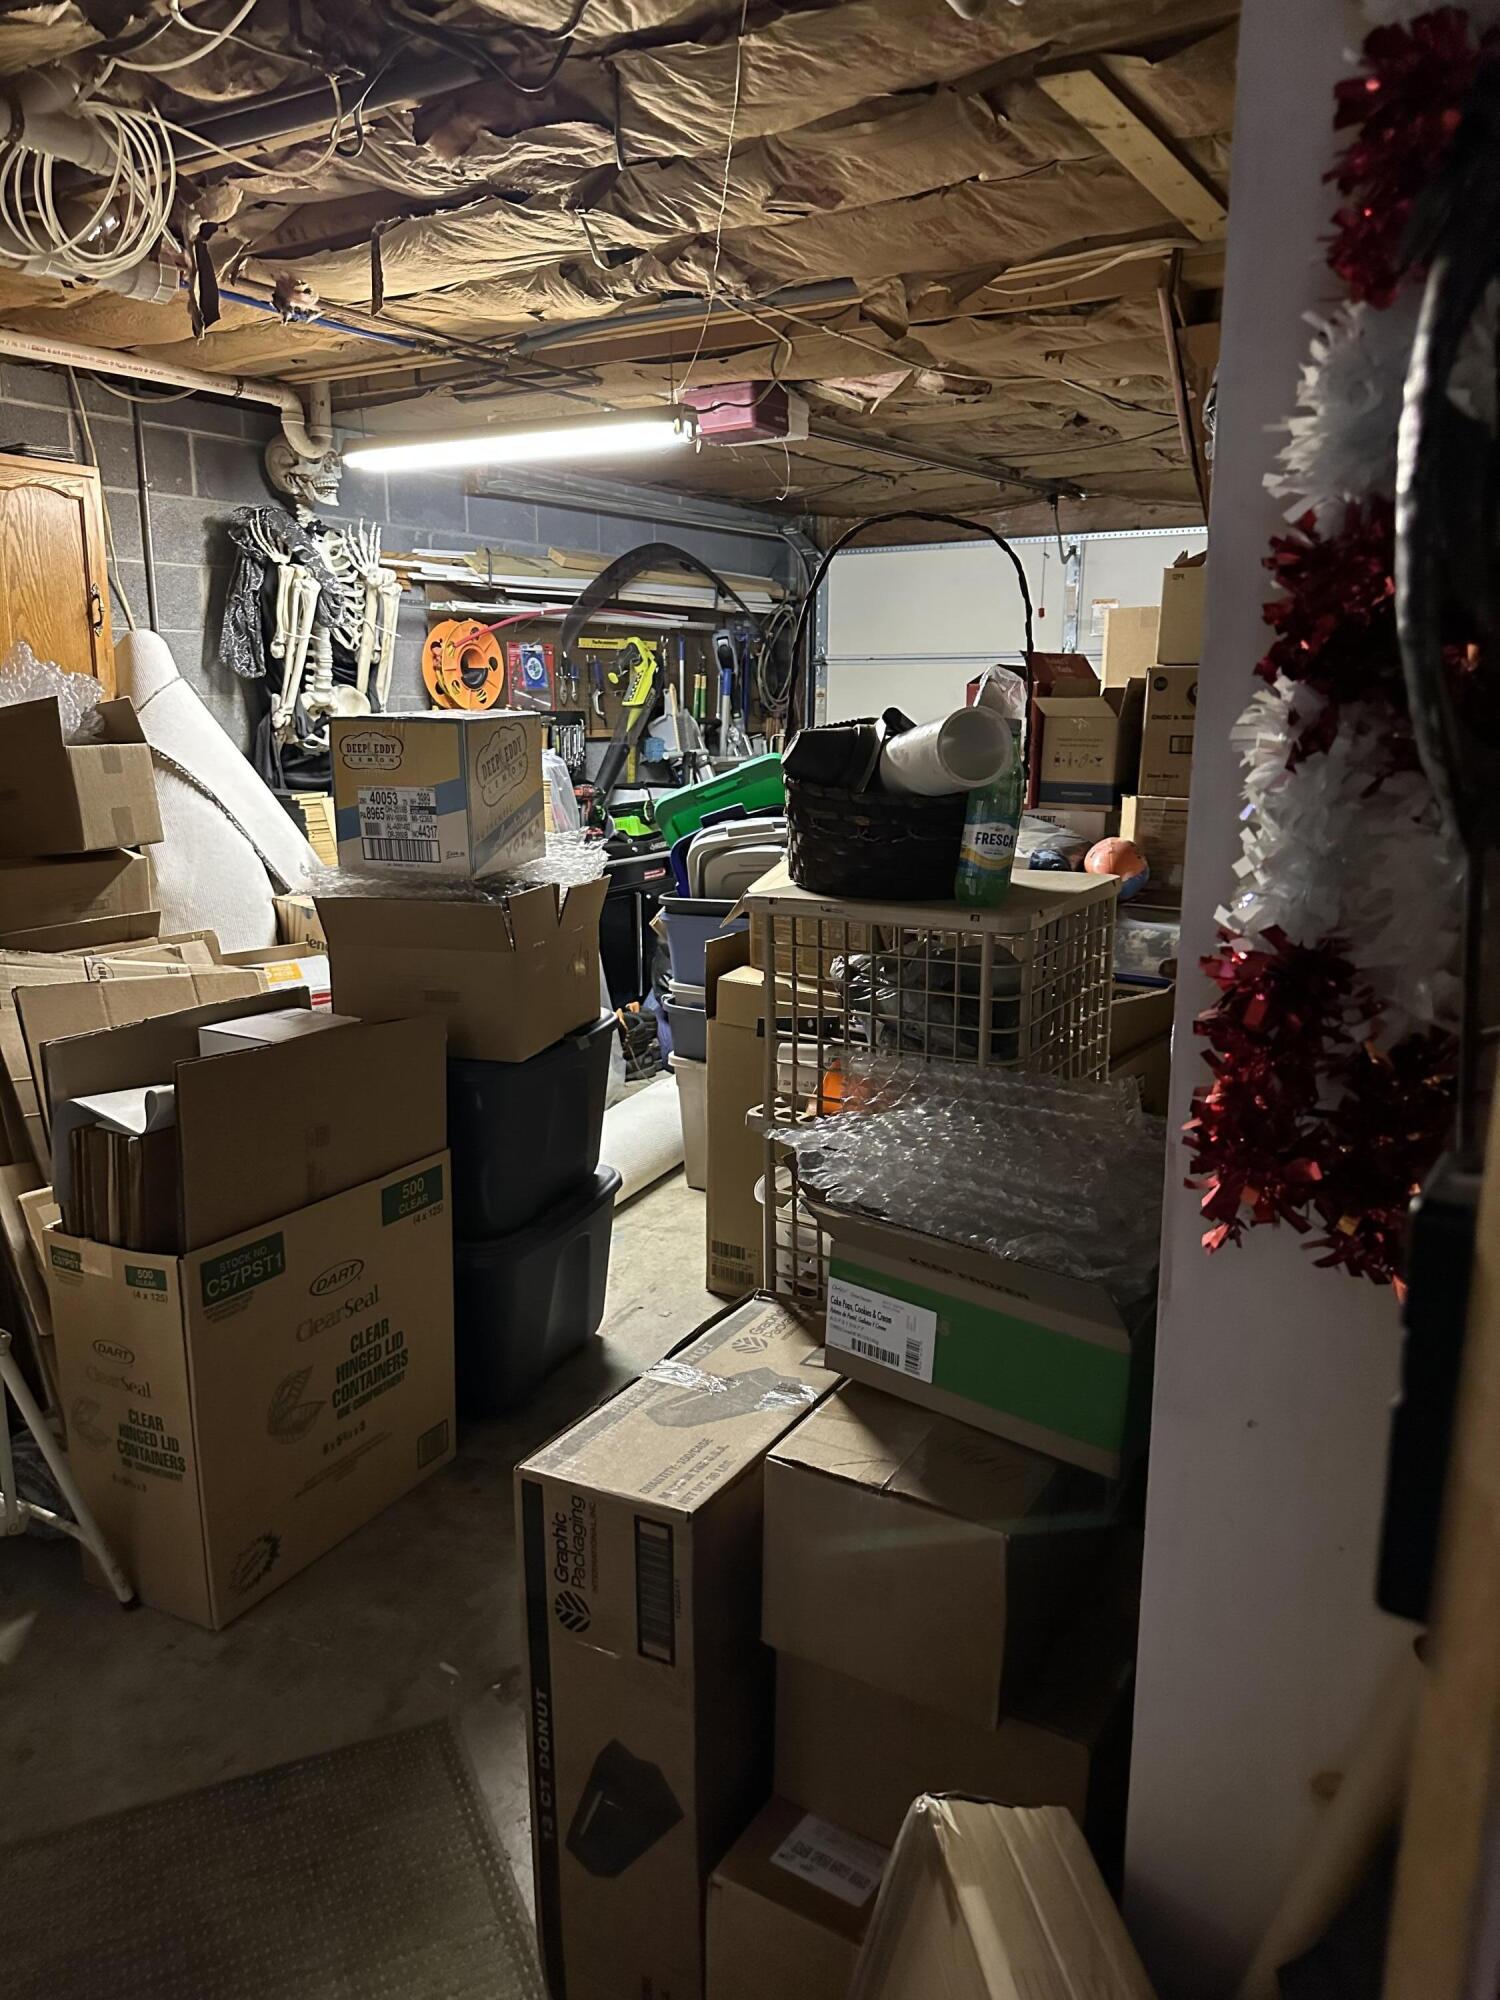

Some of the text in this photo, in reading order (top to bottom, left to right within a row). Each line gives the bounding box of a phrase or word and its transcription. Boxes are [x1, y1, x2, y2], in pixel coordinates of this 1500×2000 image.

[346, 743, 396, 754] DEEP EDDY
[482, 736, 523, 780] DEEP EDDY
[366, 806, 385, 820] 8965
[370, 791, 398, 805] 40053
[418, 825, 438, 838] 44317
[975, 831, 1014, 848] FRESCA
[402, 1177, 425, 1199] 500
[398, 1193, 429, 1215] CLEAR
[137, 1269, 153, 1280] 500
[206, 1251, 283, 1297] C57PST1
[219, 1252, 253, 1273] STOCK
[316, 1263, 357, 1292] DART
[296, 1284, 380, 1342] ClearSeal
[830, 1295, 842, 1307] Cake
[842, 1298, 855, 1313] Pops,
[855, 1303, 872, 1318] Cookies
[872, 1309, 877, 1319] &
[877, 1311, 893, 1324] Cream
[350, 1318, 389, 1354] CLEAR
[97, 1342, 130, 1361] DART
[336, 1330, 404, 1384] HINGED LID
[332, 1348, 408, 1409] CONTAINERS
[128, 1408, 164, 1432] CLEAR
[119, 1422, 179, 1453] HINGED LID
[117, 1439, 186, 1473] CONTAINERS
[638, 1463, 681, 1494] QUANTITY:
[552, 1511, 570, 1583] Graphic
[568, 1494, 587, 1590] Packaging
[535, 1686, 551, 1770] DONUT
[539, 1775, 553, 1808] CT
